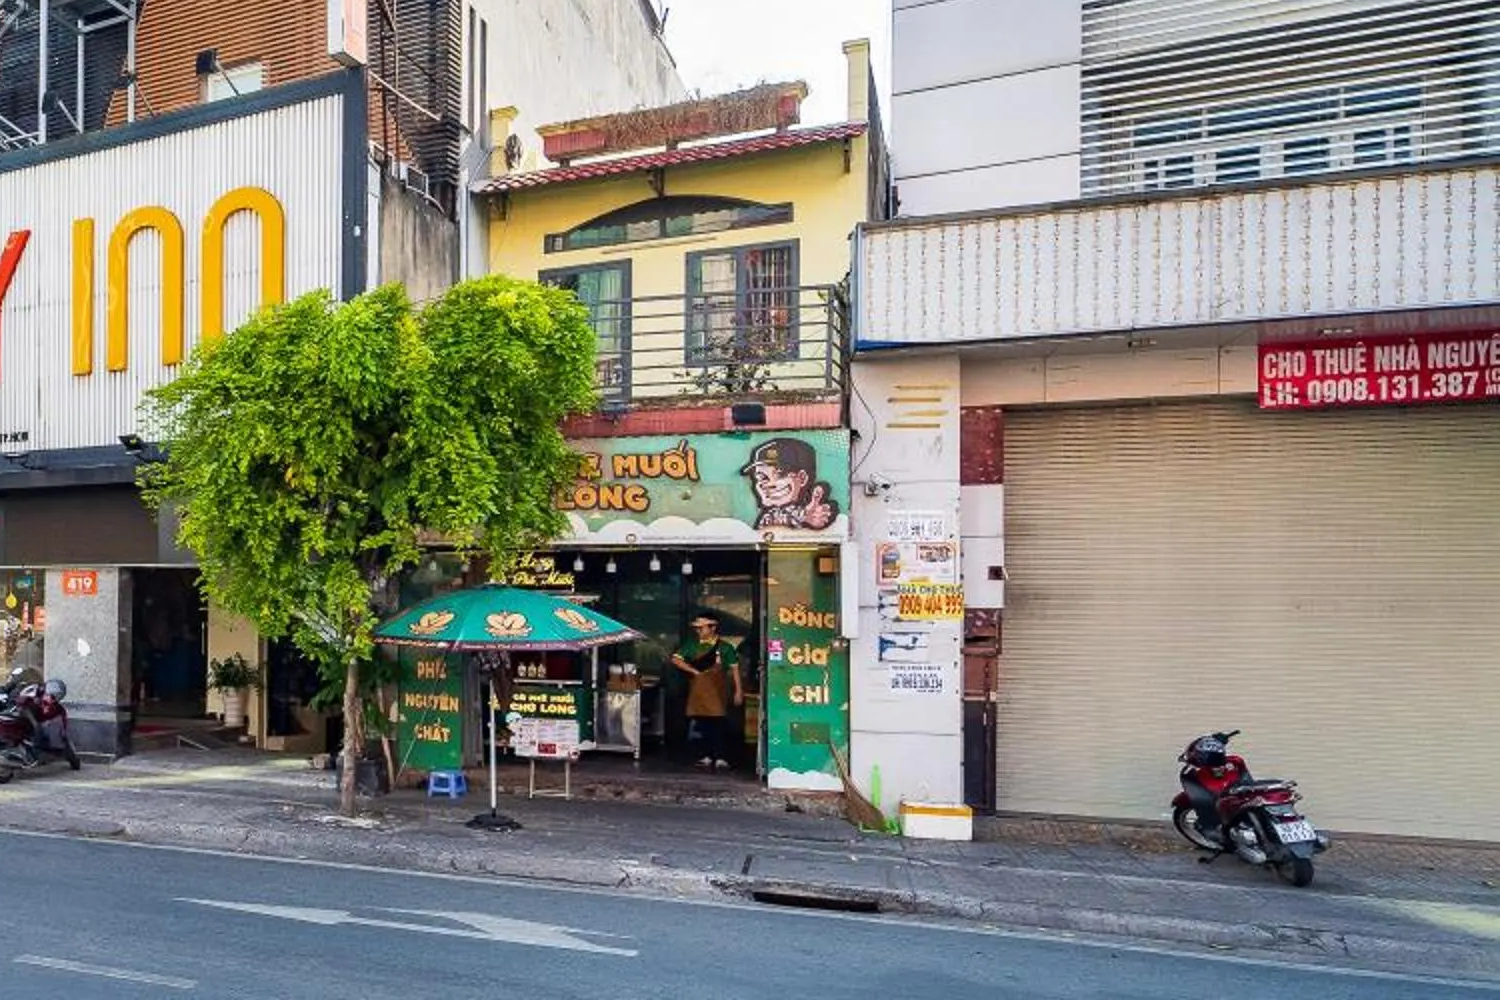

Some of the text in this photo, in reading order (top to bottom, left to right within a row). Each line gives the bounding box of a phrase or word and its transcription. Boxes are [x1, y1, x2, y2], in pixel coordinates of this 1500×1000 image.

[1263, 351, 1306, 378] CHO
[1312, 342, 1367, 376] THUÊ
[1374, 338, 1420, 372] NHÀ
[1263, 381, 1300, 407] LH:
[1307, 371, 1479, 404] 0908.131.387
[612, 439, 699, 481] MUỐI
[555, 483, 650, 512] LONG
[67, 577, 92, 590] 419
[540, 703, 577, 715] LONG
